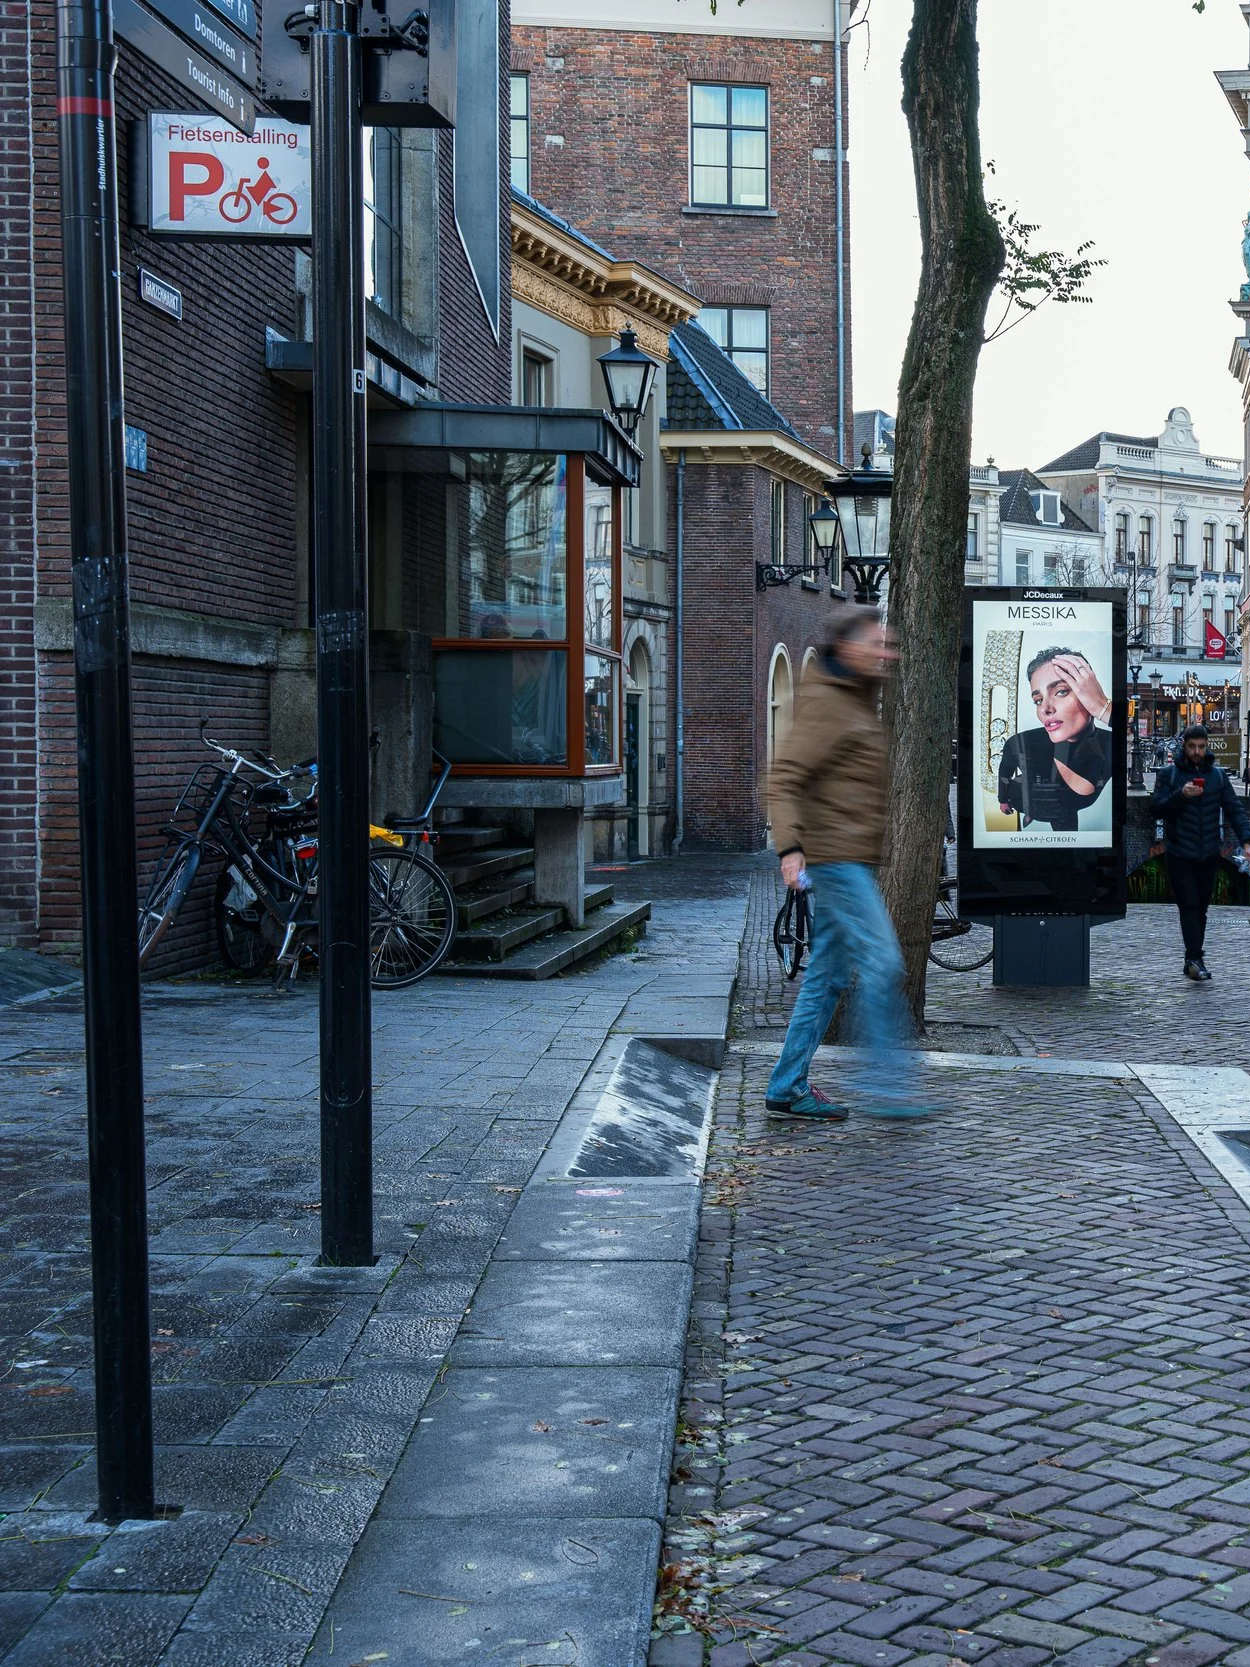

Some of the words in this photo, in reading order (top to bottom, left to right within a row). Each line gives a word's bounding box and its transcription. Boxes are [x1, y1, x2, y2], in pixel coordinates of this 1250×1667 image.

[194, 13, 236, 62] Domtoren
[187, 58, 216, 96] Tourist
[218, 83, 234, 109] Info
[169, 151, 224, 221] P
[356, 372, 363, 389] 6
[1023, 591, 1064, 599] JCDecaux
[1008, 606, 1077, 620] MESSIKA
